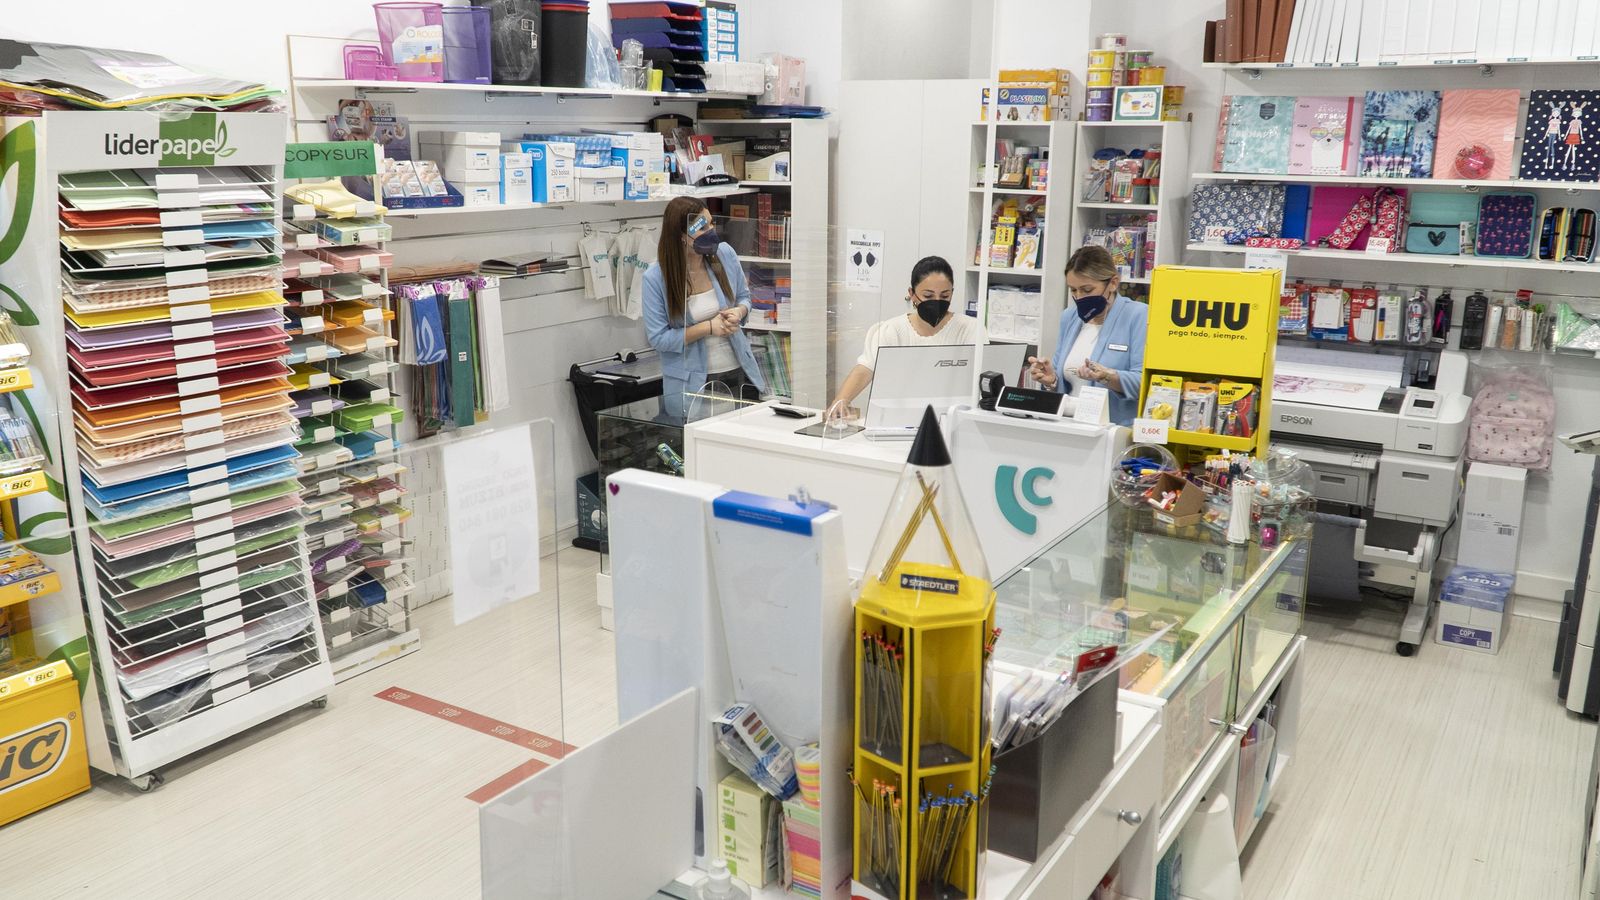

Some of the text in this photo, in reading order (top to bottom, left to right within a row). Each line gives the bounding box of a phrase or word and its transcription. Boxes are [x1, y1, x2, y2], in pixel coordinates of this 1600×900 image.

[285, 148, 369, 163] COPYSUR
[1171, 298, 1251, 331] UHU
[1213, 332, 1248, 340] siempre.
[934, 359, 969, 367] ASUS
[1280, 414, 1313, 425] EPSON
[1141, 427, 1161, 435] 0,60€
[909, 579, 956, 591] STAEDTLER
[1459, 575, 1501, 587] COPY
[1459, 629, 1476, 638] COPY
[388, 691, 411, 701] STOP
[438, 707, 461, 718] STOP
[491, 725, 516, 736] STOP
[528, 737, 553, 749] STOP
